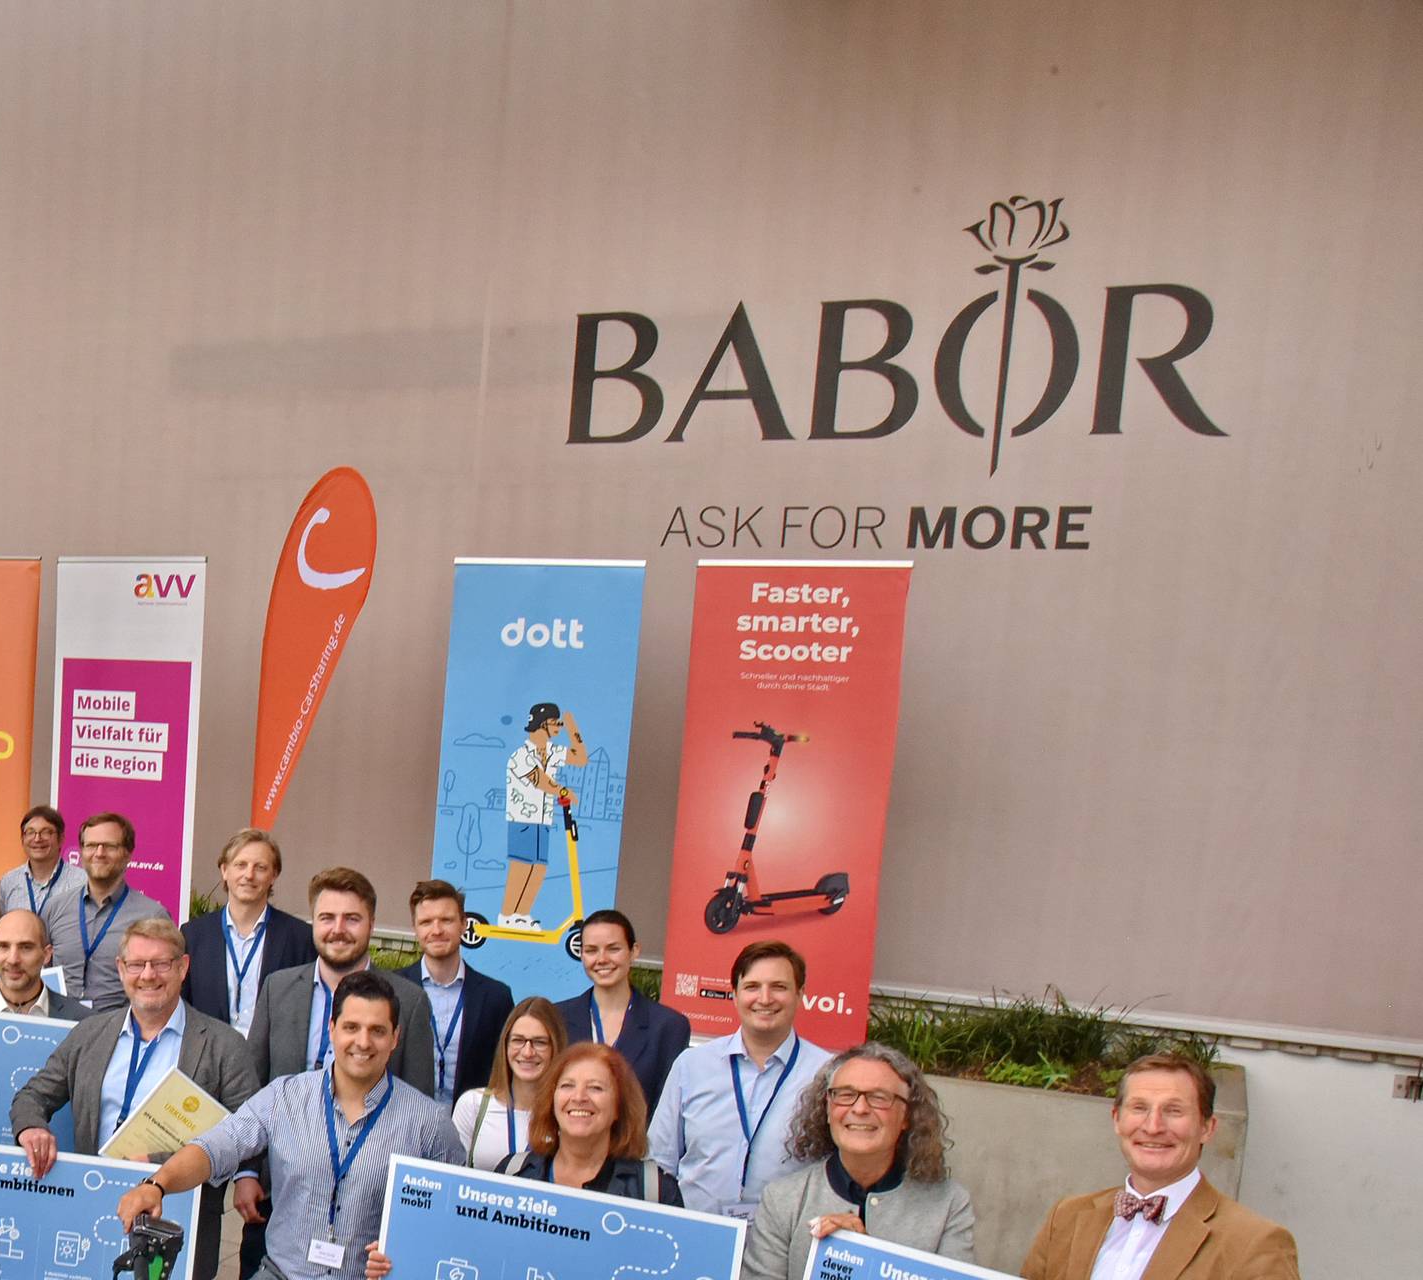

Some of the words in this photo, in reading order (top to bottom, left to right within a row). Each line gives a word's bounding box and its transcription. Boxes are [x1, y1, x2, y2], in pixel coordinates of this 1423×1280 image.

[565, 281, 1230, 448] BABOR
[660, 505, 764, 549] ASK
[779, 505, 886, 549] FOR
[906, 505, 1093, 551] MORE
[134, 574, 196, 598] avv
[752, 582, 850, 608] Faster,
[501, 617, 584, 649] dott
[737, 613, 859, 638] smarter,
[739, 639, 853, 663] Scooter
[740, 671, 777, 681] Schneller
[779, 672, 796, 681] und
[797, 673, 850, 683] nachhaltiger
[756, 682, 780, 690] durch
[781, 683, 806, 691] deine
[77, 696, 131, 712] Mobile
[264, 613, 346, 811] www.cambio-CarSharing.de
[76, 724, 134, 742] Vielfalt
[138, 727, 163, 743] für
[75, 752, 99, 768] die
[104, 755, 157, 775] Region
[126, 861, 165, 871] w.avv.de
[802, 992, 853, 1015] voi.
[9, 1161, 34, 1177] Zie
[401, 1185, 433, 1200] clever
[402, 1173, 442, 1191] Aachen
[401, 1196, 431, 1210] mobil
[458, 1183, 515, 1209] Unsere
[517, 1195, 558, 1217] Ziele
[456, 1202, 488, 1222] und
[492, 1210, 591, 1242] Ambitionen
[822, 1258, 854, 1275] clever
[825, 1246, 864, 1267] Aachen
